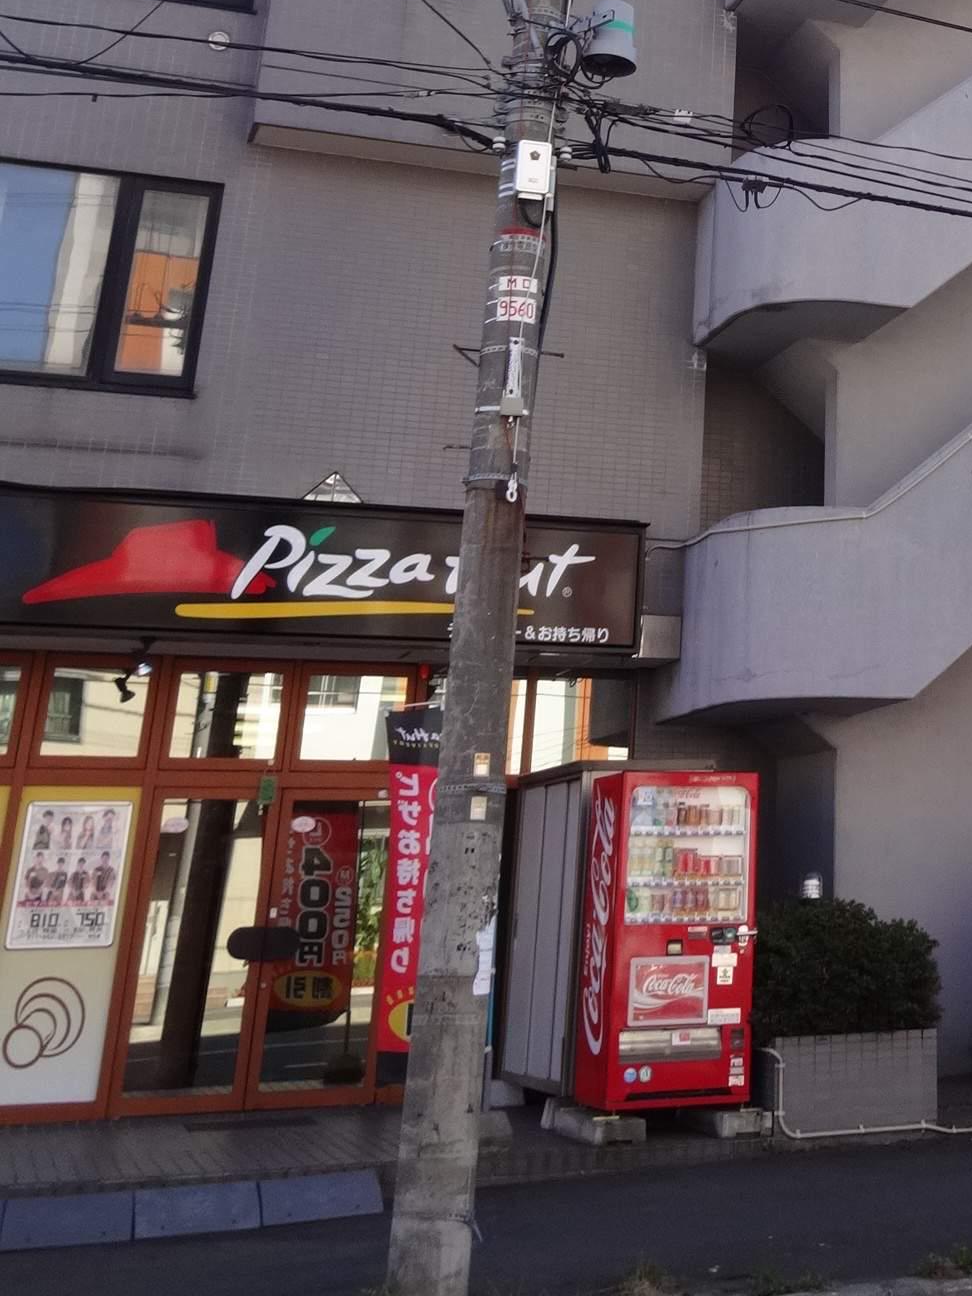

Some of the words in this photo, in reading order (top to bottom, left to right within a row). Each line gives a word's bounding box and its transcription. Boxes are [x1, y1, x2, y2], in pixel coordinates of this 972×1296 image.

[231, 524, 435, 599] Pizza
[445, 544, 596, 598] ut
[30, 913, 59, 928] 810
[76, 912, 105, 927] 750
